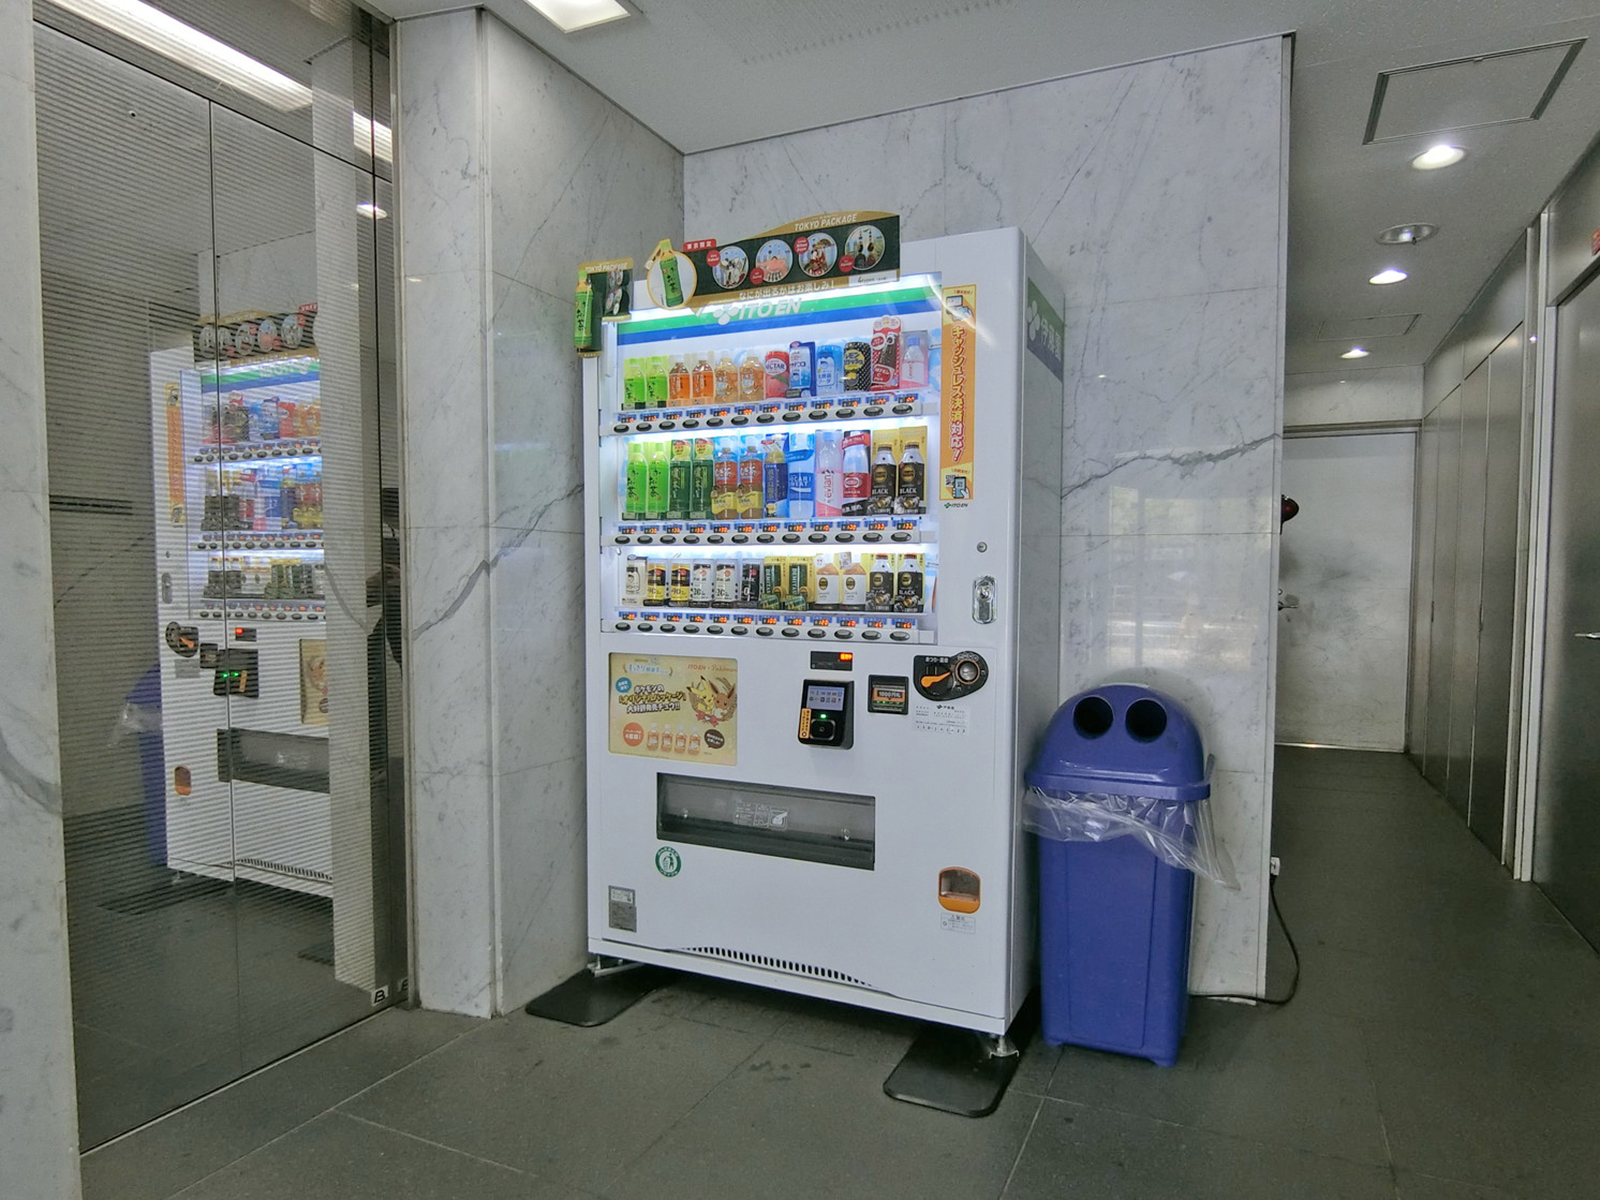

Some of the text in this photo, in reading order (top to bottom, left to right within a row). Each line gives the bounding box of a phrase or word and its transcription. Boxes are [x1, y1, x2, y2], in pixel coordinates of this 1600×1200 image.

[794, 213, 858, 231] TOKYO PACKAGE
[739, 298, 803, 320] ITO EN
[824, 474, 833, 499] evian
[900, 487, 917, 495] BLACK
[899, 588, 915, 596] BLACK
[374, 989, 386, 1004] B
